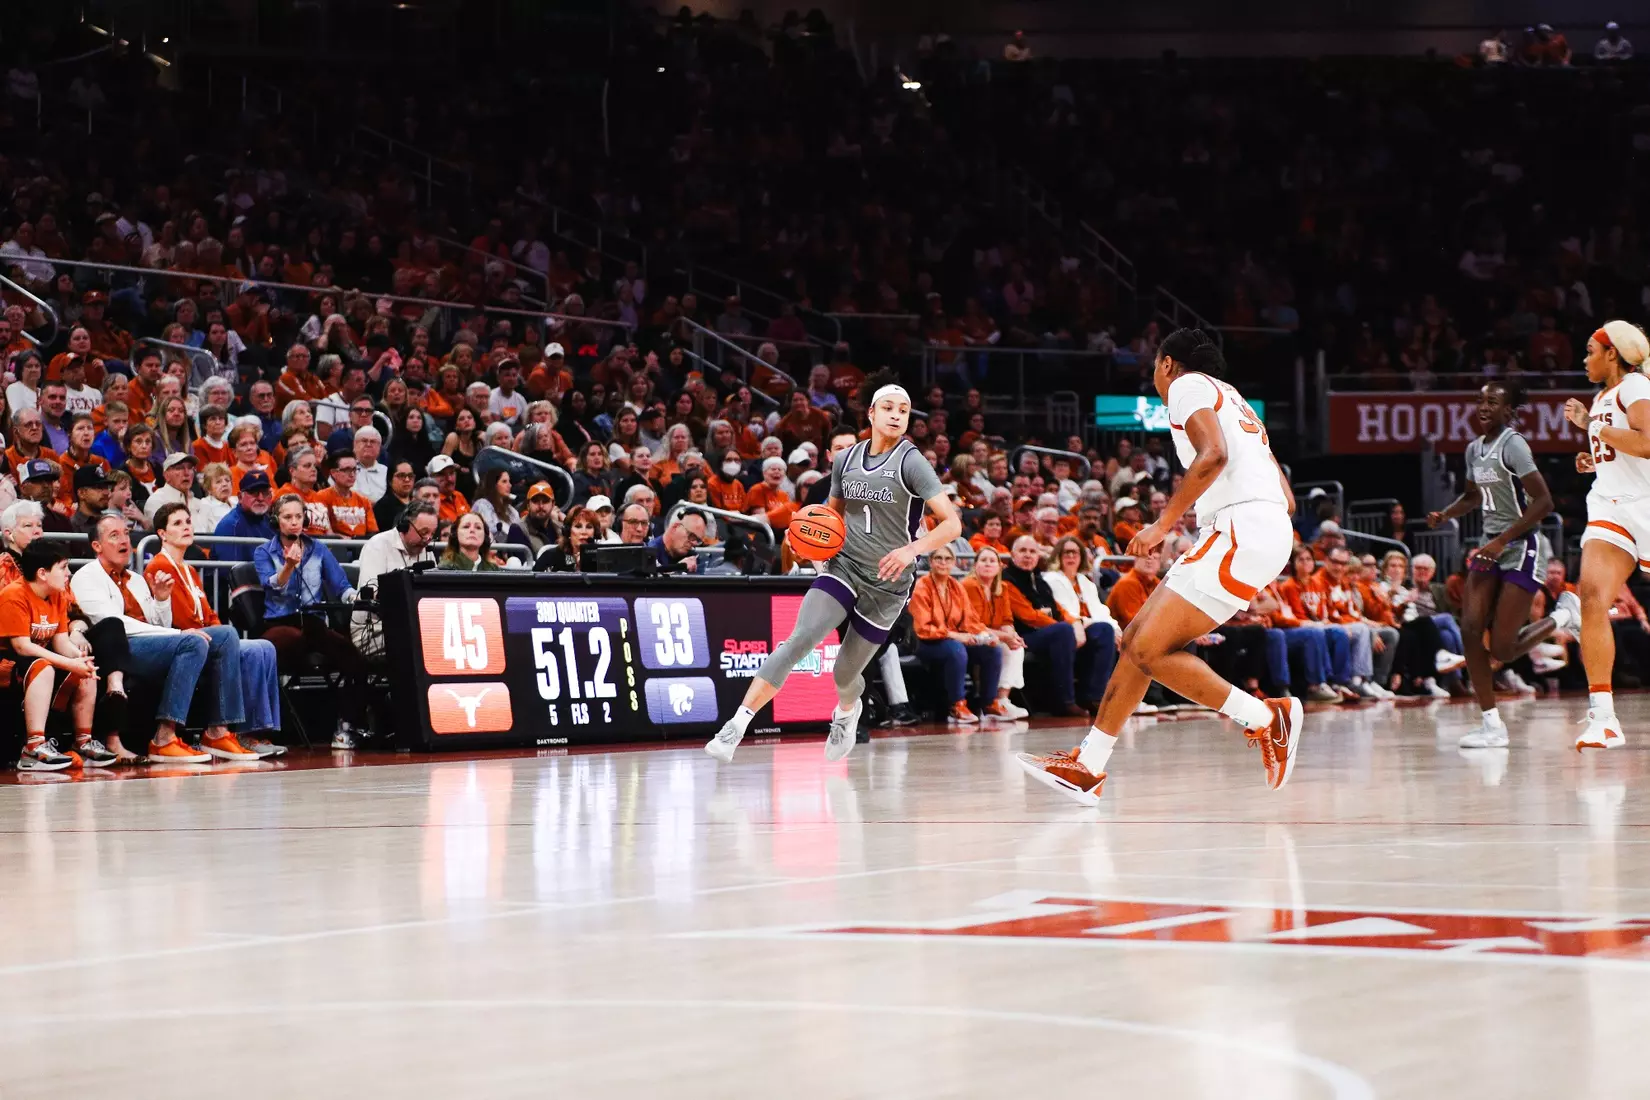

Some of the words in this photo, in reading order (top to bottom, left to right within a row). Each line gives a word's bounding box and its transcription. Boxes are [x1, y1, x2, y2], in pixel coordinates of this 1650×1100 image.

[1357, 403, 1479, 441] HOOK
[842, 480, 897, 503] Wildcats
[863, 504, 872, 534] 1
[800, 525, 830, 541] ELITE
[536, 601, 558, 623] 3RD
[557, 601, 600, 624] QUARTER
[442, 602, 488, 670] 45
[651, 602, 694, 667] 33
[724, 639, 767, 654] SUPER
[531, 626, 617, 700] 51.2
[720, 652, 769, 669] START
[549, 704, 558, 726] 5
[571, 703, 590, 725] FLS
[602, 701, 612, 723] 2
